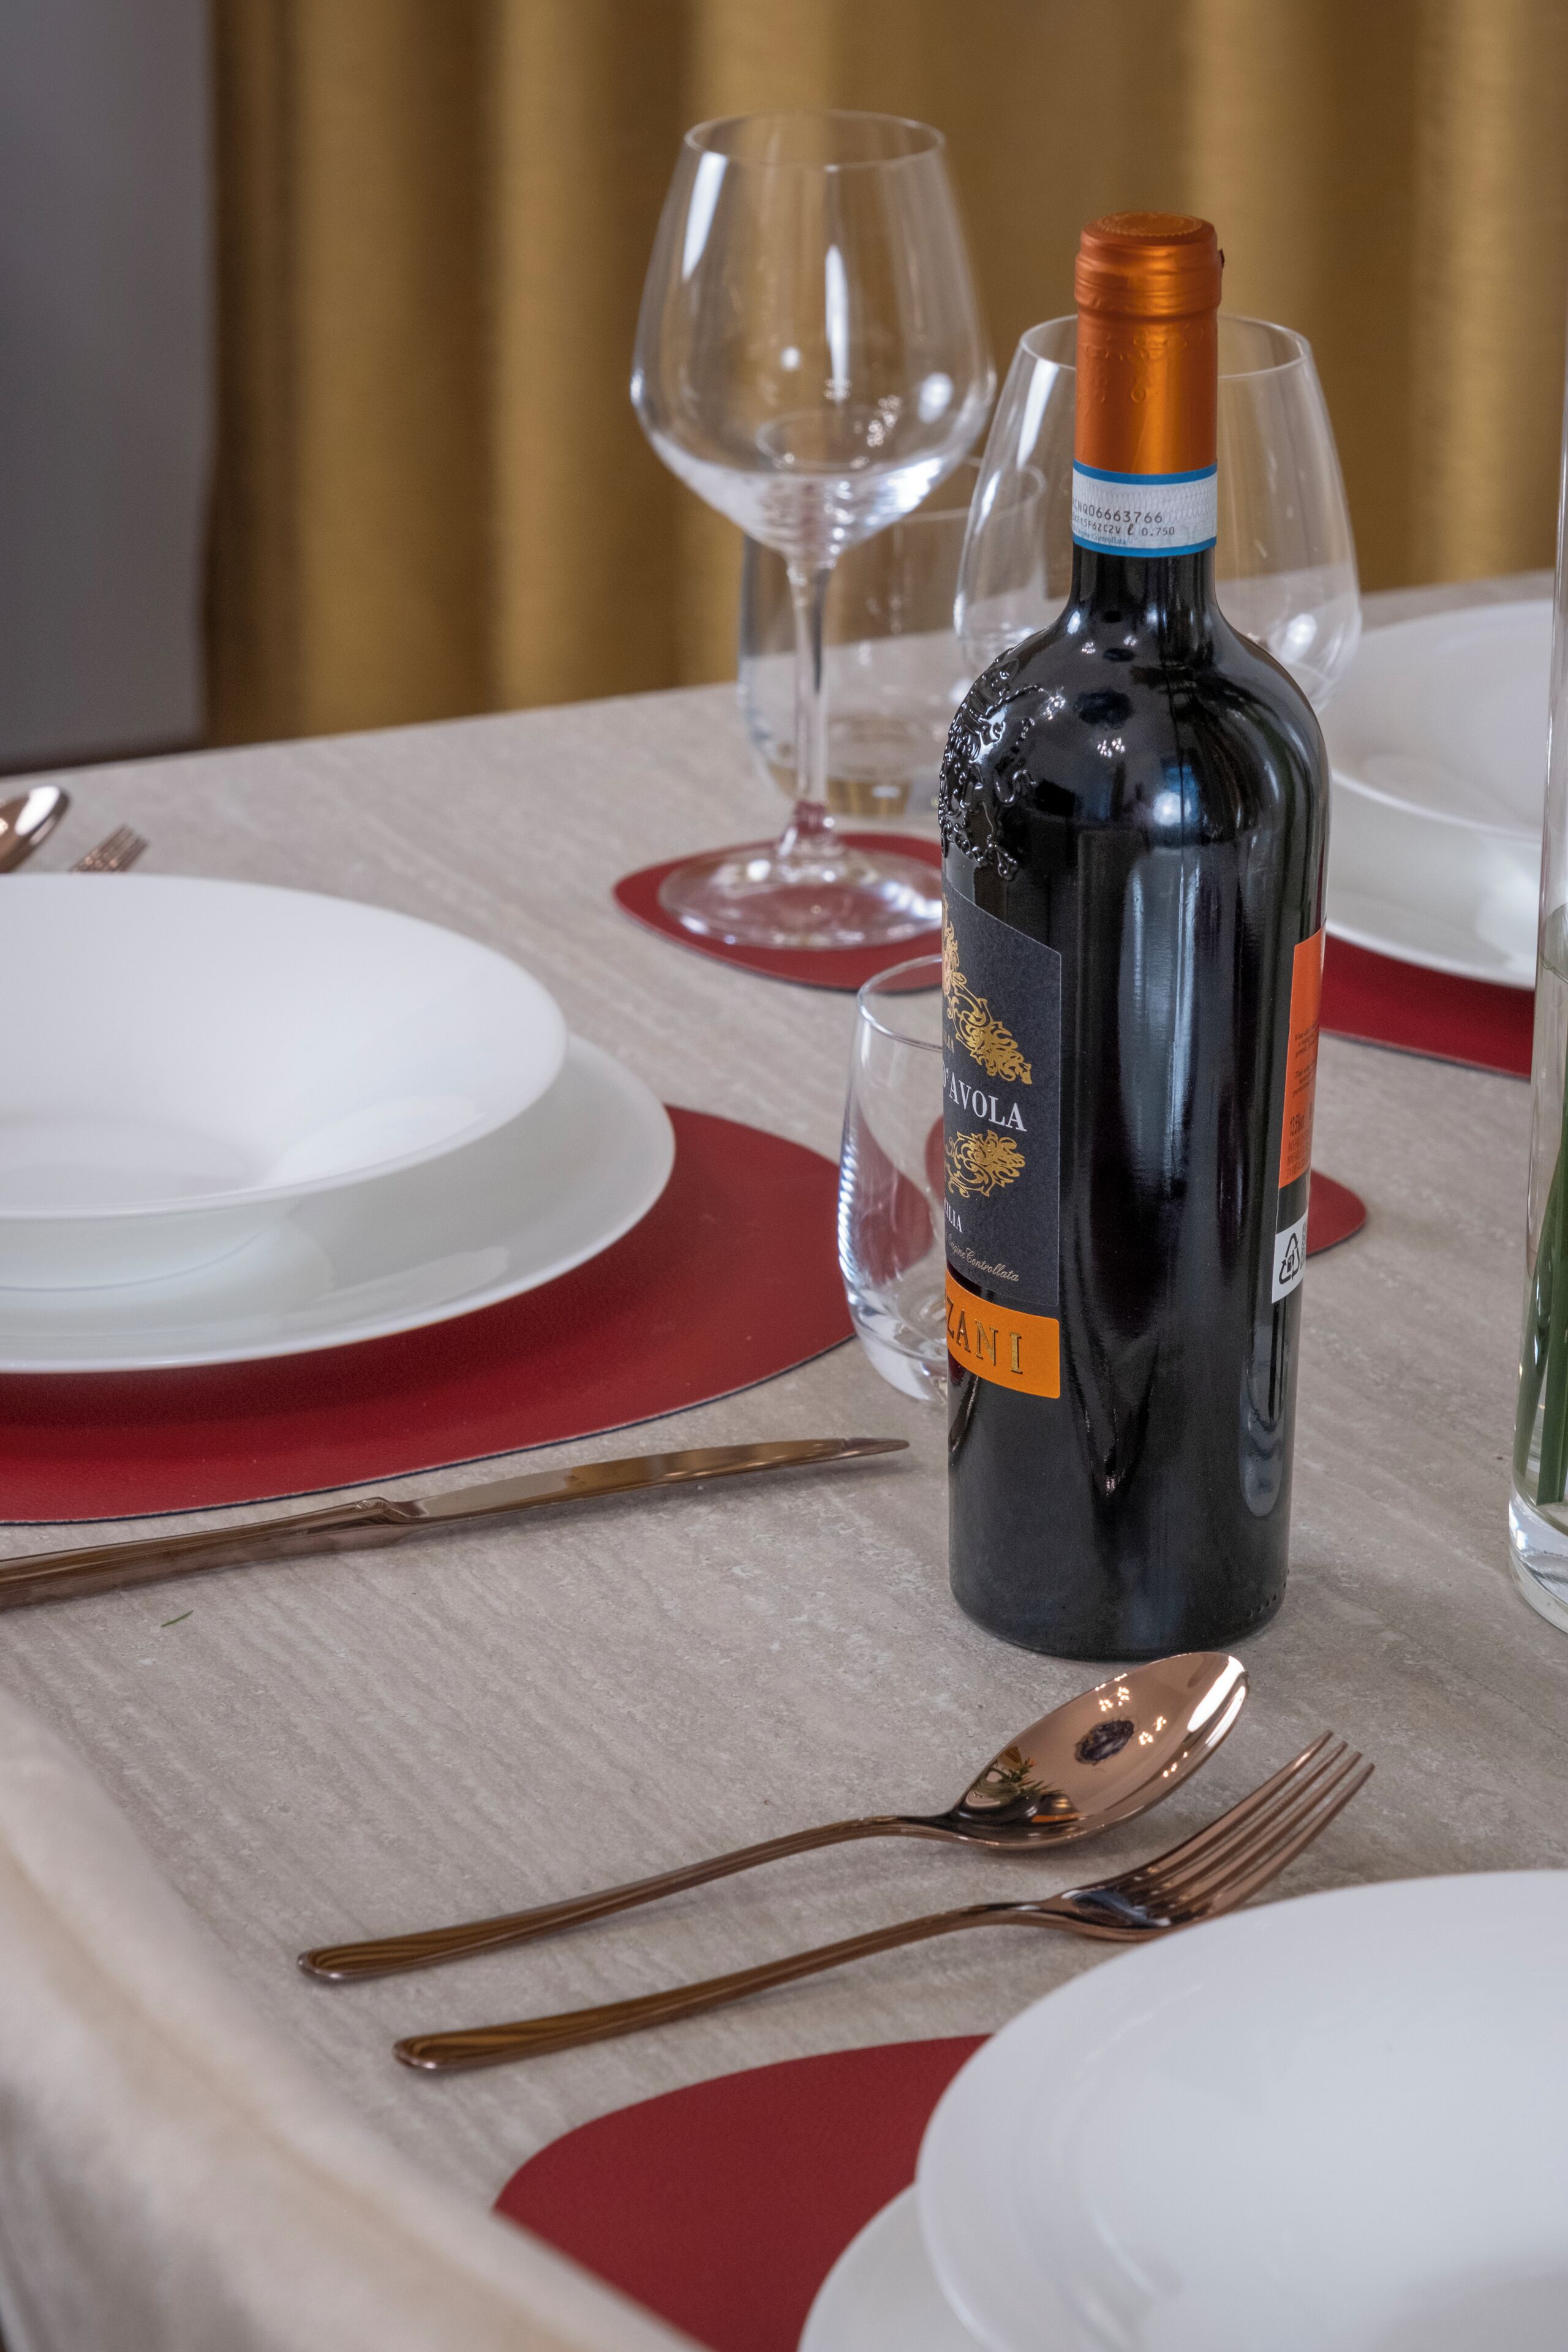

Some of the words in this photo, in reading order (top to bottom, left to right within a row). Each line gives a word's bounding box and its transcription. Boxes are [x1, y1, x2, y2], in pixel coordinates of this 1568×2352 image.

[1073, 498, 1163, 523] CNQ06663766
[1141, 526, 1175, 537] 0.750
[965, 1247, 1019, 1282] Controllata
[945, 1289, 1023, 1374] ZANI
